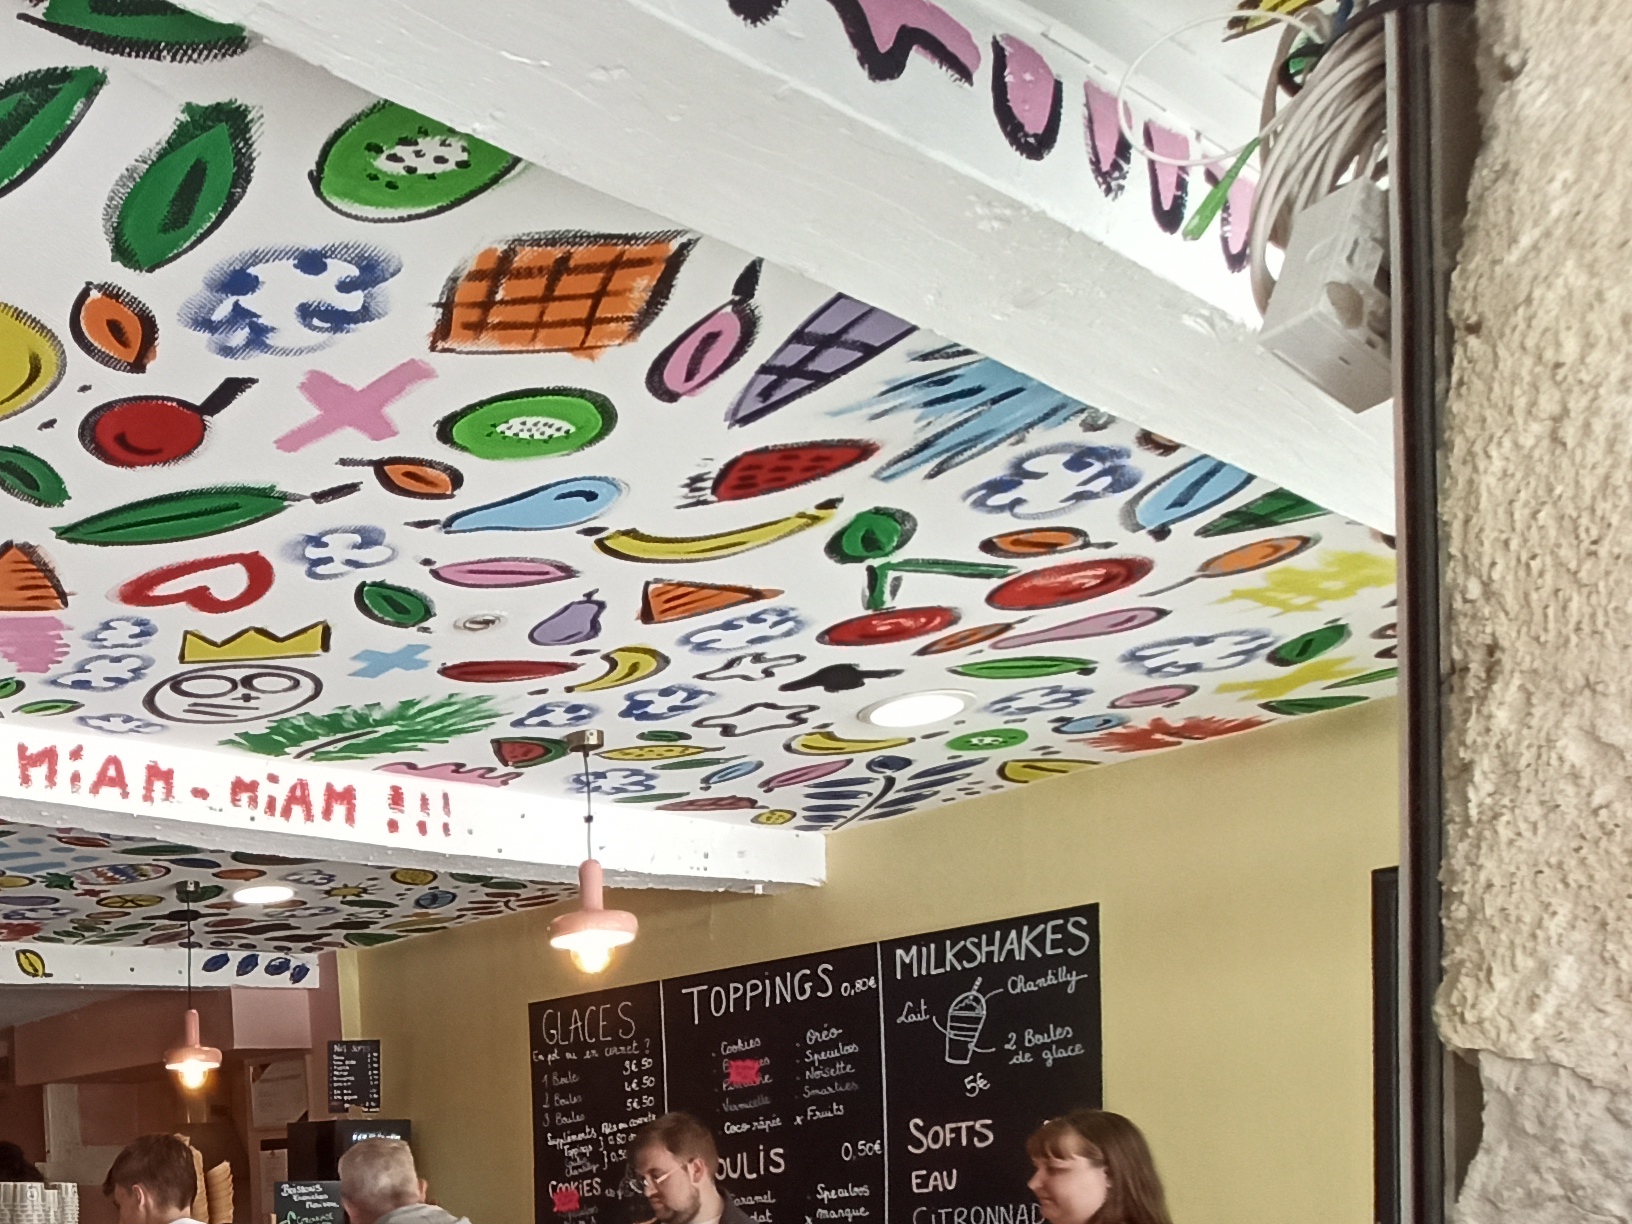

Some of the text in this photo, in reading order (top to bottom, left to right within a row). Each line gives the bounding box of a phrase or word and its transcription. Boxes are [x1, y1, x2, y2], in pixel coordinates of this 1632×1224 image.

[1007, 965, 1089, 994] Chantilly
[542, 1001, 636, 1045] GLACES
[896, 998, 931, 1024] Lait
[604, 1040, 640, 1057] cornet
[721, 1037, 762, 1056] Cookies
[1004, 1023, 1074, 1051] 2 Boules
[1008, 1043, 1085, 1068] de glace
[805, 1062, 856, 1080] Noisette
[802, 1082, 859, 1098] Smarties
[555, 1111, 586, 1126] Boules
[806, 1102, 845, 1121] Fruits
[907, 1117, 995, 1155] SOFTS
[714, 1144, 786, 1181] OULiS
[911, 1168, 958, 1194] EAU
